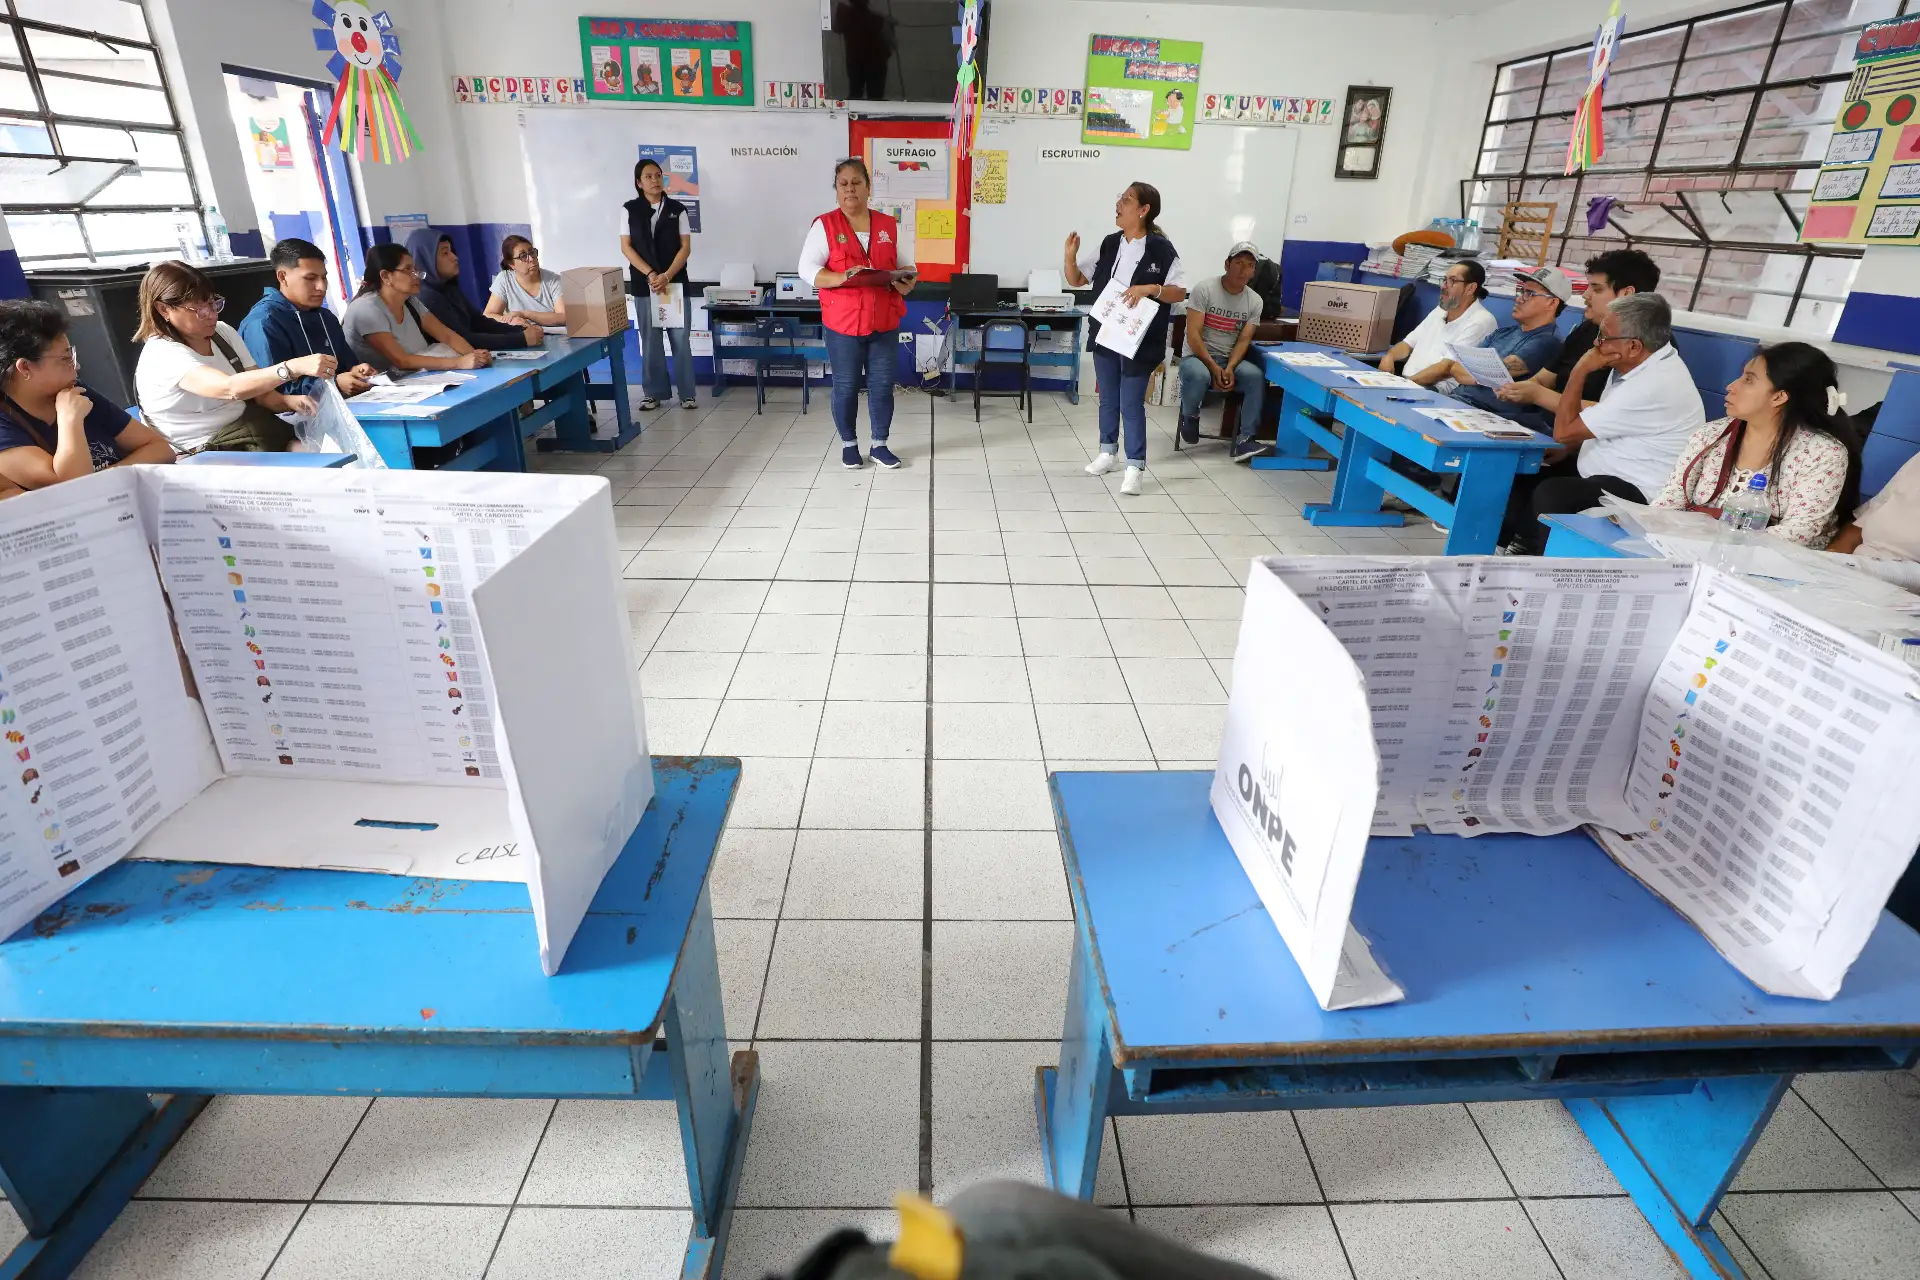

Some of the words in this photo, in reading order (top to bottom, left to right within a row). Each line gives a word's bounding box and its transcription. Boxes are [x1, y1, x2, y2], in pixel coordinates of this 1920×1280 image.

[590, 20, 620, 36] LEO
[625, 22, 636, 36] Y
[1858, 20, 1920, 53] CUM
[1092, 38, 1143, 53] JUEGO
[1146, 41, 1158, 56] Y
[456, 78, 468, 92] A
[472, 78, 484, 92] B
[489, 78, 500, 92] C
[506, 78, 518, 92] D
[522, 79, 534, 93] E
[540, 80, 550, 93] F
[556, 80, 568, 93] G
[574, 80, 585, 93] H
[769, 82, 776, 97] I
[784, 83, 793, 97] J
[800, 84, 813, 98] K
[987, 88, 999, 102] N
[1004, 88, 1015, 103] Ñ
[1021, 89, 1032, 103] O
[1038, 90, 1048, 103] P
[1054, 89, 1066, 105] Q
[1072, 90, 1082, 105] R
[1206, 94, 1216, 109] S
[1224, 95, 1234, 109] T
[1240, 96, 1251, 110] U
[1256, 96, 1267, 110] V
[1272, 99, 1284, 111] W
[1288, 99, 1300, 113] X
[1305, 100, 1316, 113] Y
[1321, 100, 1332, 115] Z
[731, 145, 798, 156] INSTALACIÓN
[886, 148, 936, 157] SUFRAGIO
[1042, 149, 1100, 159] ESCRUTINIO
[1208, 306, 1248, 319] ADIDAS
[1328, 300, 1348, 309] ONPE
[1238, 763, 1297, 878] ONPE
